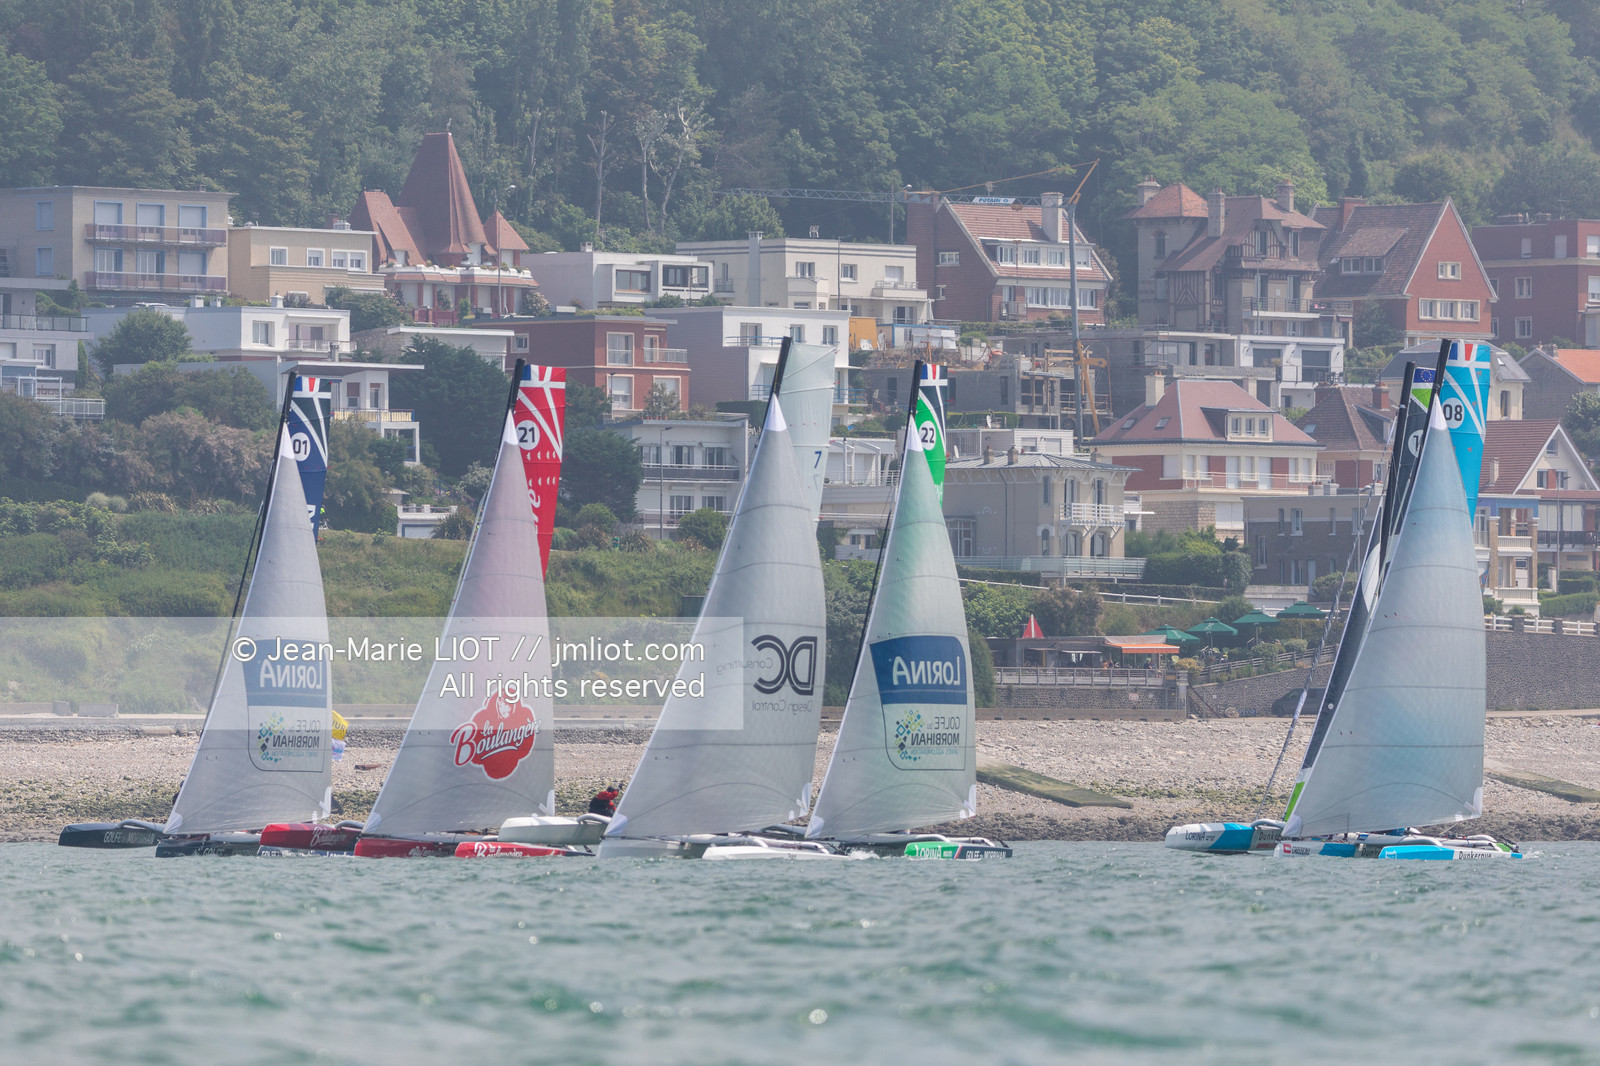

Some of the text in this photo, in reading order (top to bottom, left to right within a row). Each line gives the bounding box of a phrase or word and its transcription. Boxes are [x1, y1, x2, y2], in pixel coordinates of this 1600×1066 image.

[1442, 403, 1463, 422] 08
[518, 426, 535, 443] 21
[921, 427, 934, 444] 22
[293, 438, 308, 455] 01
[814, 450, 822, 469] 7
[481, 720, 493, 737] la
[449, 717, 542, 768] Boulangère
